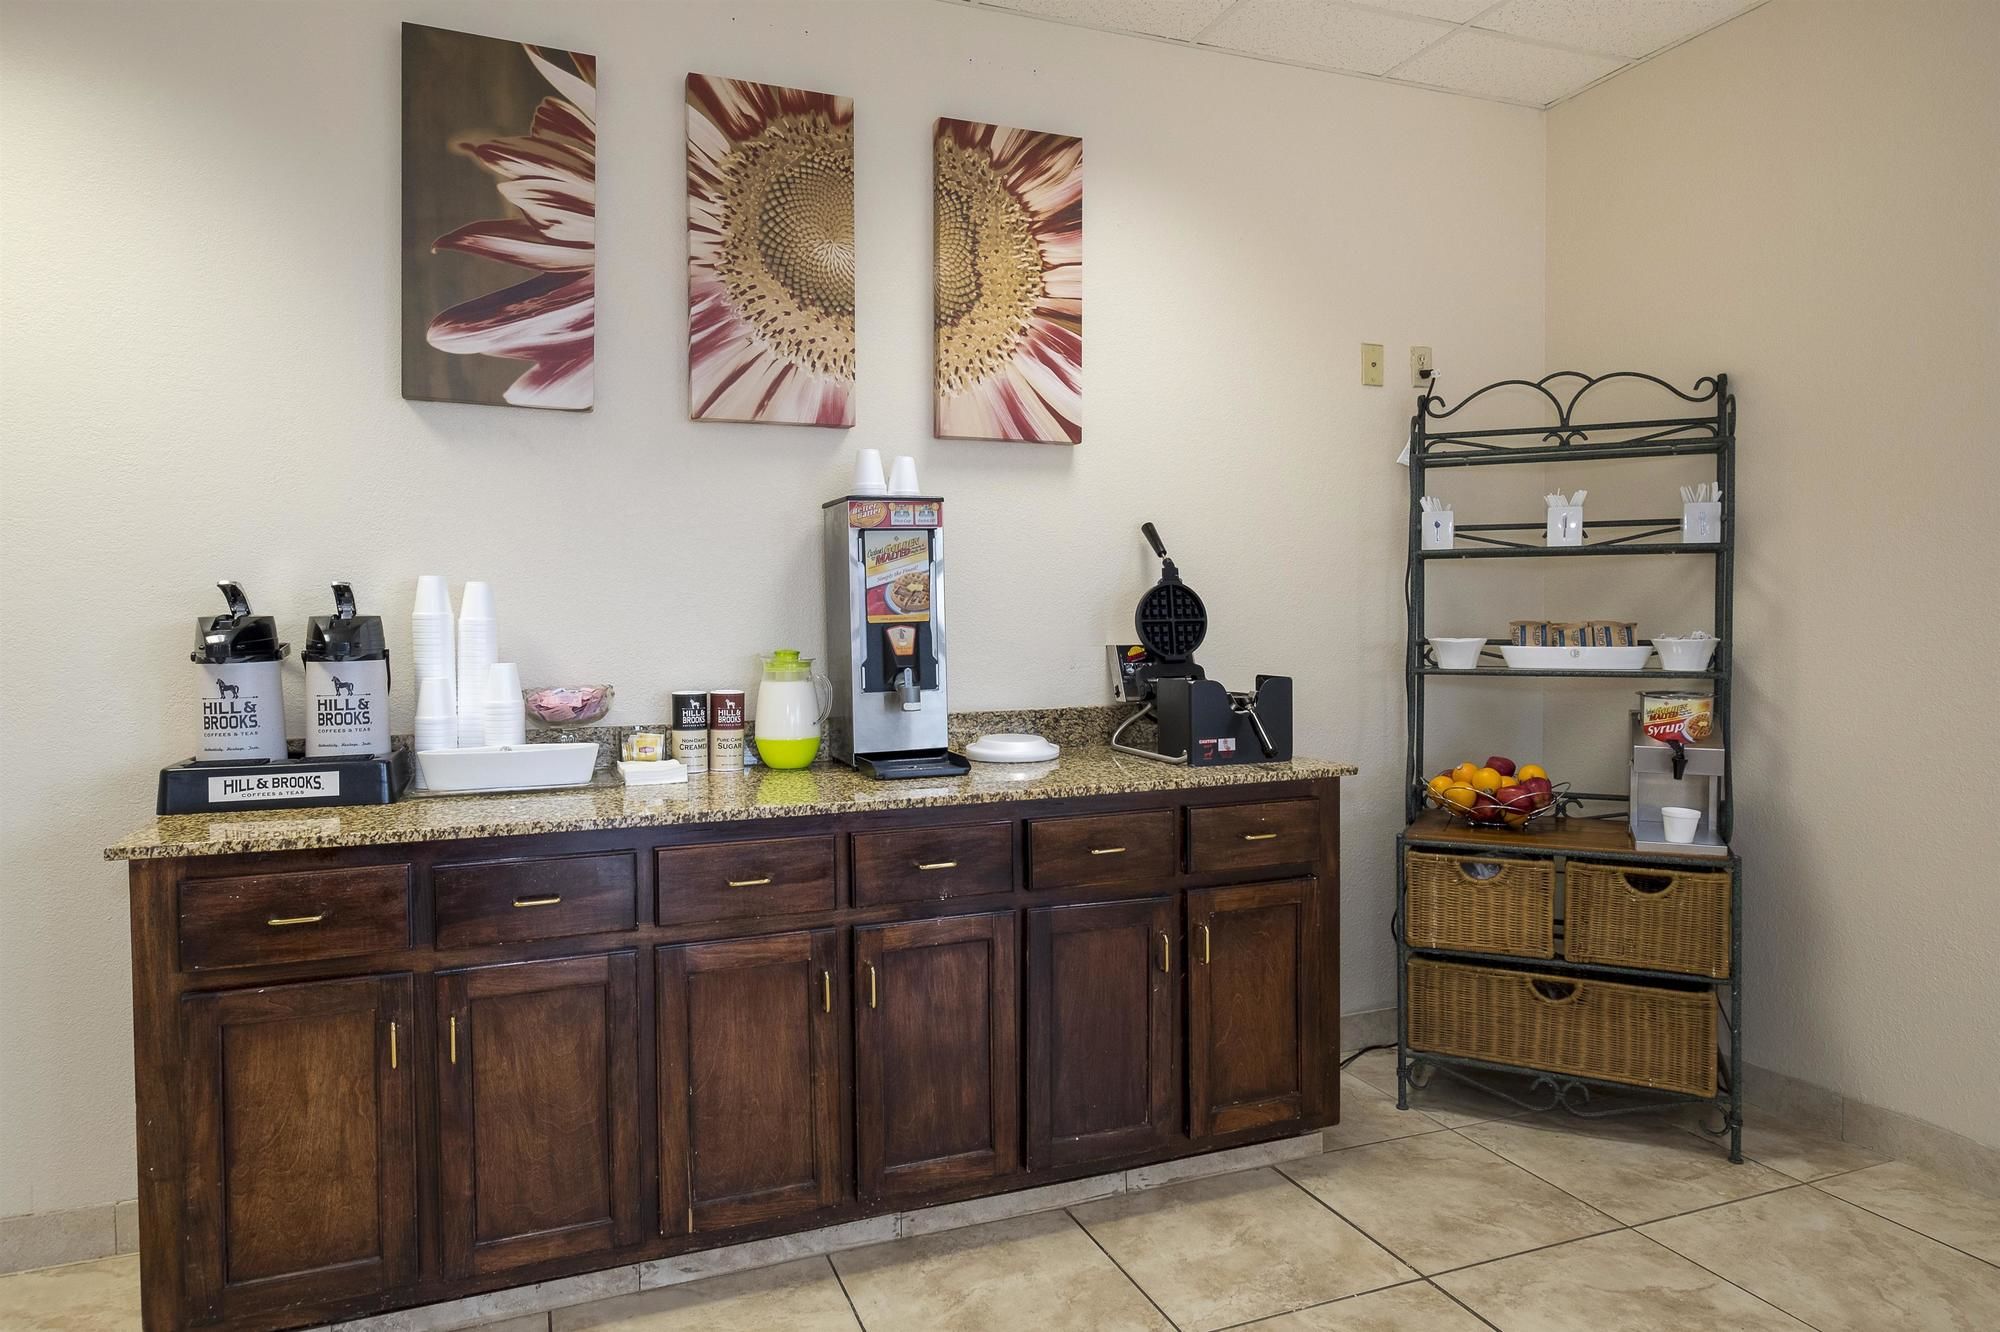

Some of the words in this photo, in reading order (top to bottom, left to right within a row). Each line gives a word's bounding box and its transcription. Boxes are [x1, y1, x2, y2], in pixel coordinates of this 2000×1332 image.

[875, 548, 912, 566] MALTED
[203, 701, 241, 715] HILL
[244, 701, 257, 714] &
[318, 699, 355, 712] HILL
[358, 698, 370, 710] &
[682, 716, 706, 724] BROOKS
[1648, 723, 1684, 737] Syrup
[224, 778, 254, 796] HILL
[257, 778, 269, 789] &
